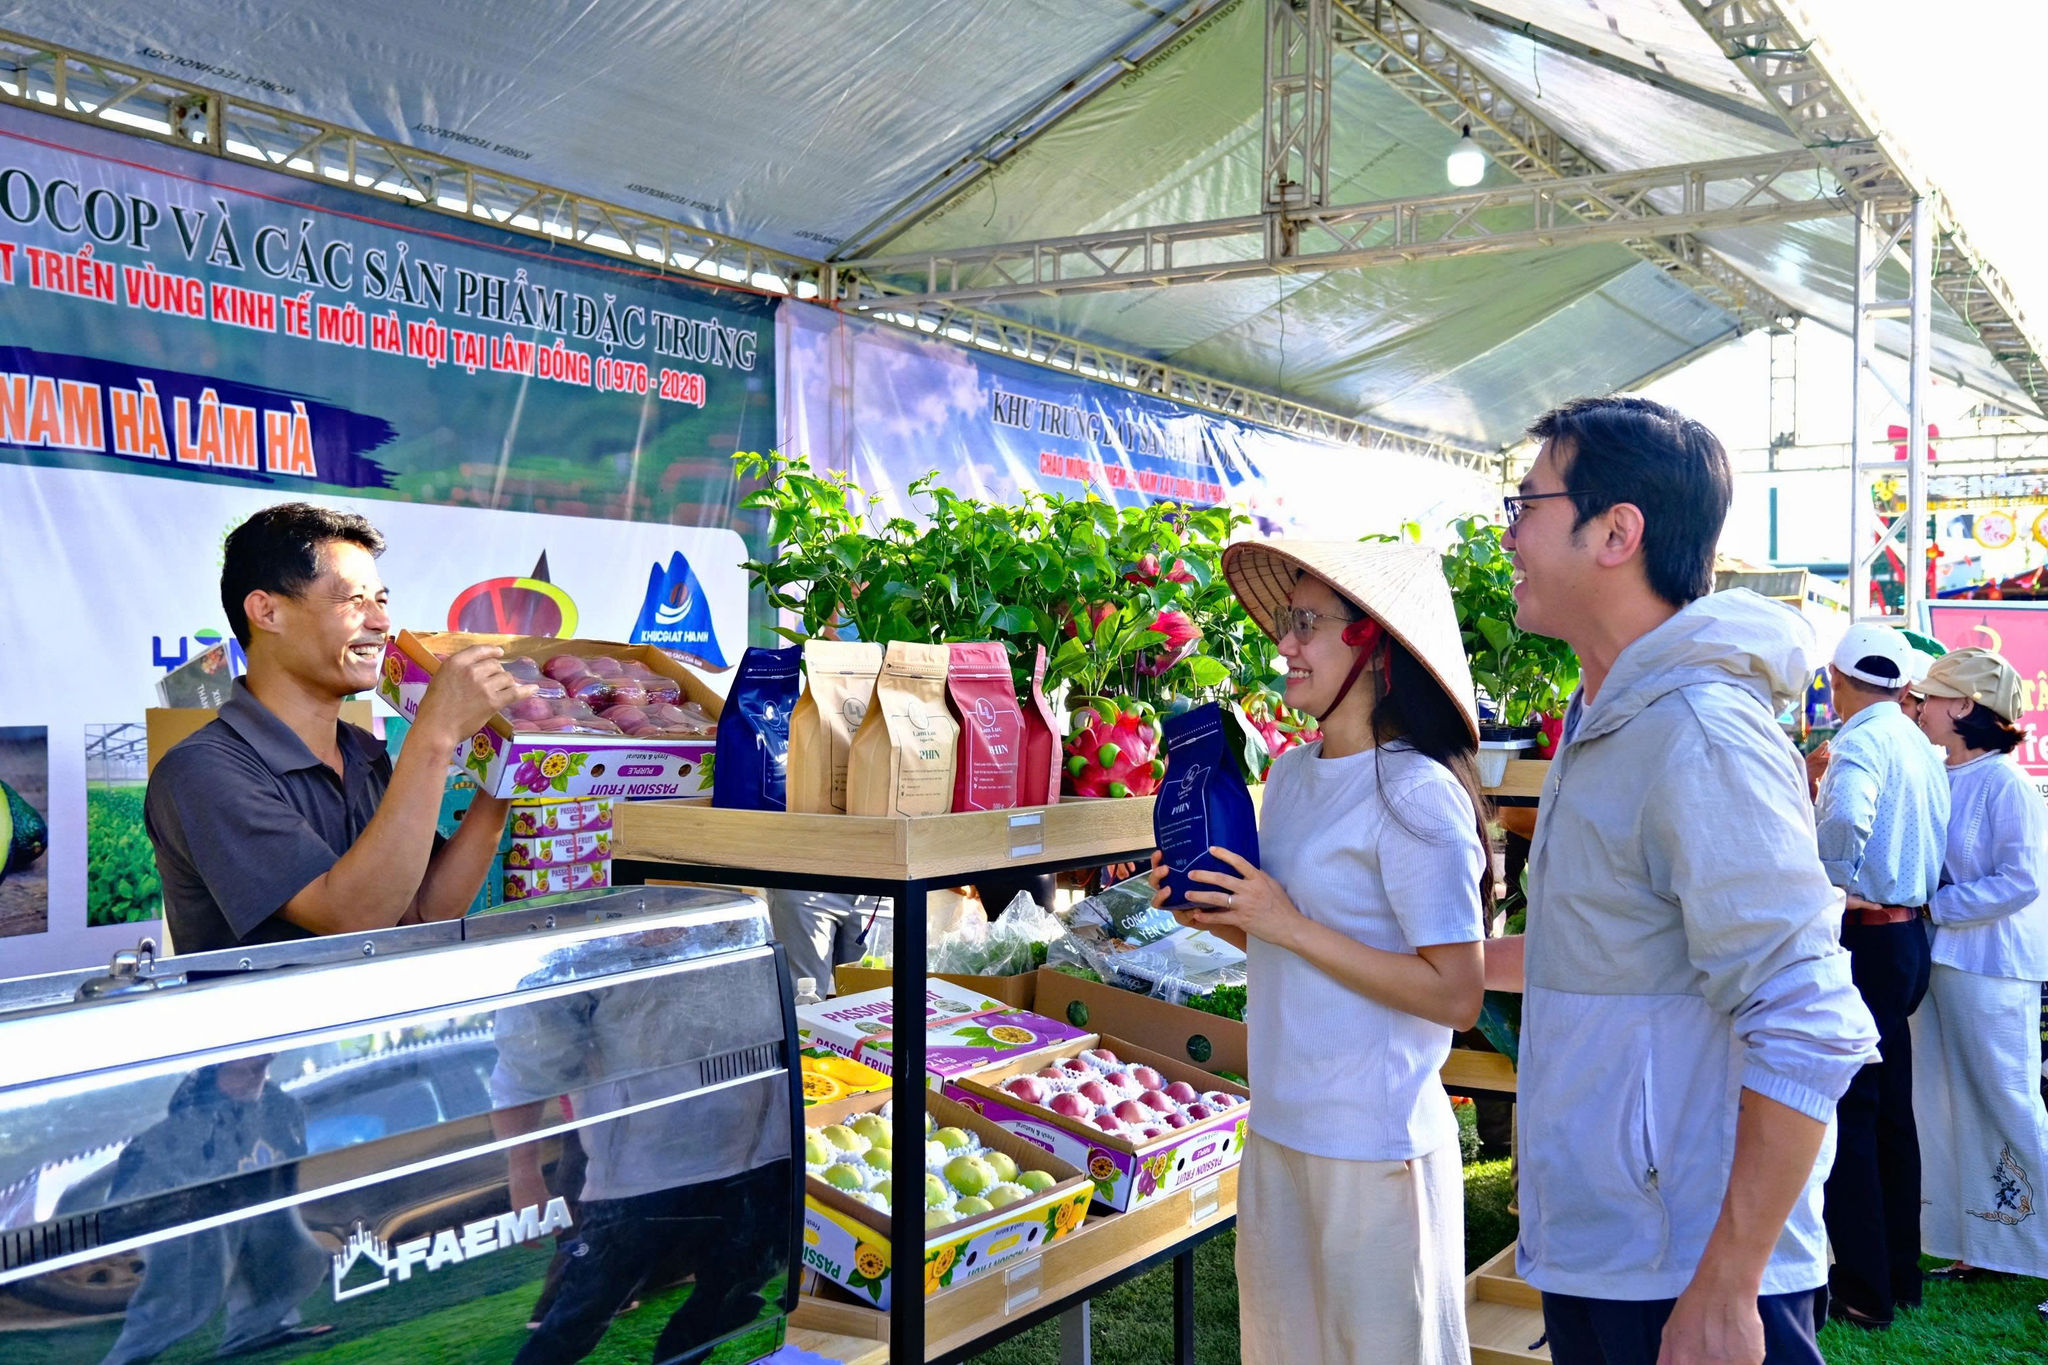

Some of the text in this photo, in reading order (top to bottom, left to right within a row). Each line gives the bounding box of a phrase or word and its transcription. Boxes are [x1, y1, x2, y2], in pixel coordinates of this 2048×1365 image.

[136, 47, 242, 81] TECHNOLOGY
[412, 122, 492, 149] TECHNOLOGY
[0, 168, 758, 372] OCOP VÀ CÁC SẢN PHẨM ĐẶC TRƯNG
[25, 243, 117, 304] TRIỂN
[122, 261, 206, 321] VÙNG
[211, 284, 277, 333] KINH
[282, 291, 312, 340] TẾ
[317, 302, 366, 349] MỚI
[371, 309, 404, 356] HÀ
[407, 319, 446, 369] NỘI
[452, 330, 487, 374] TẠI
[490, 334, 535, 378] LÂM
[537, 338, 591, 387] ĐỒNG
[595, 360, 648, 396] (1976
[659, 370, 707, 409] 2026)
[0, 372, 318, 478] NAM HÀ LÂM HÀ
[992, 389, 1036, 430] KHU
[628, 767, 655, 775] PURPLE
[587, 783, 679, 796] PASSION FRUIT
[1121, 910, 1147, 930] CÔNG
[821, 1000, 893, 1023] PASSION
[1175, 1155, 1223, 1187] PASSION FRUIT
[386, 1196, 573, 1281] FAEMA
[803, 1246, 841, 1280] PASSI
